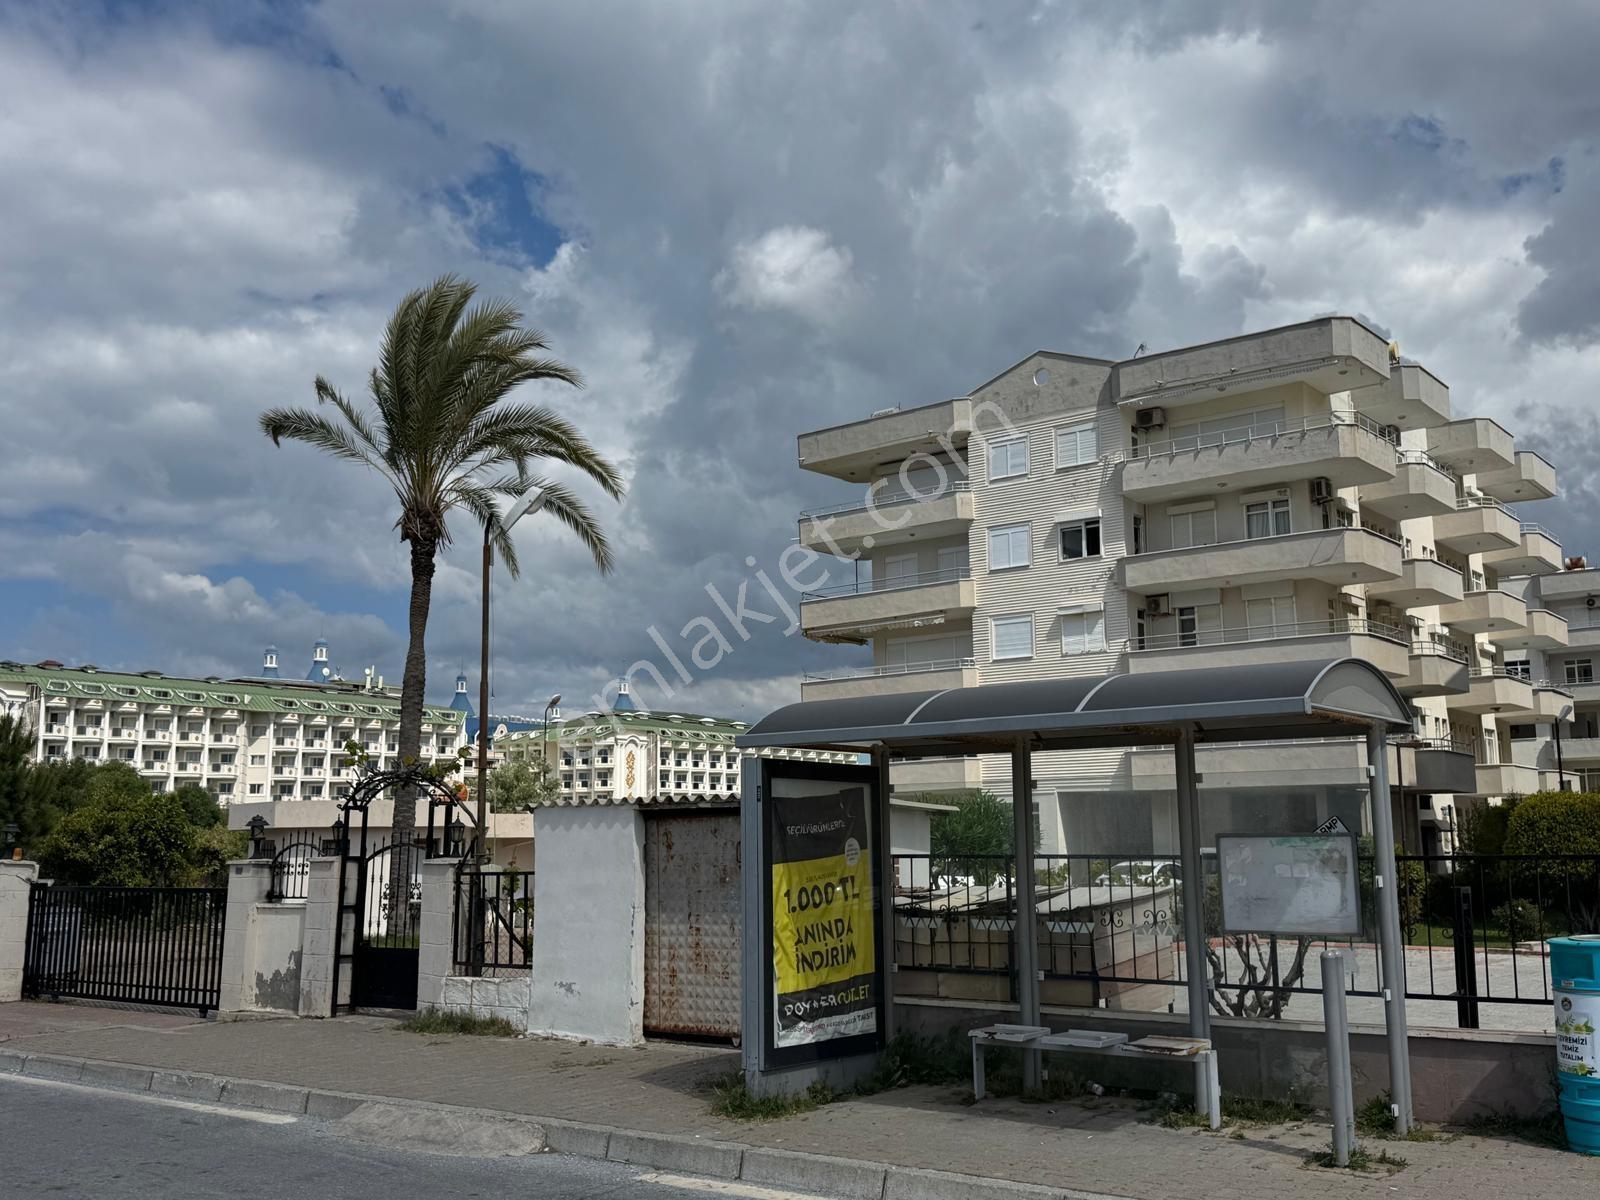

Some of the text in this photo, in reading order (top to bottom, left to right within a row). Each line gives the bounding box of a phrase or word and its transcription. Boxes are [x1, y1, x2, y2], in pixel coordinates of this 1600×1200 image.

[784, 882, 835, 914] 1.000
[839, 875, 860, 902] TL
[795, 914, 854, 946] ANINDA
[795, 938, 857, 974] İNDİRİM
